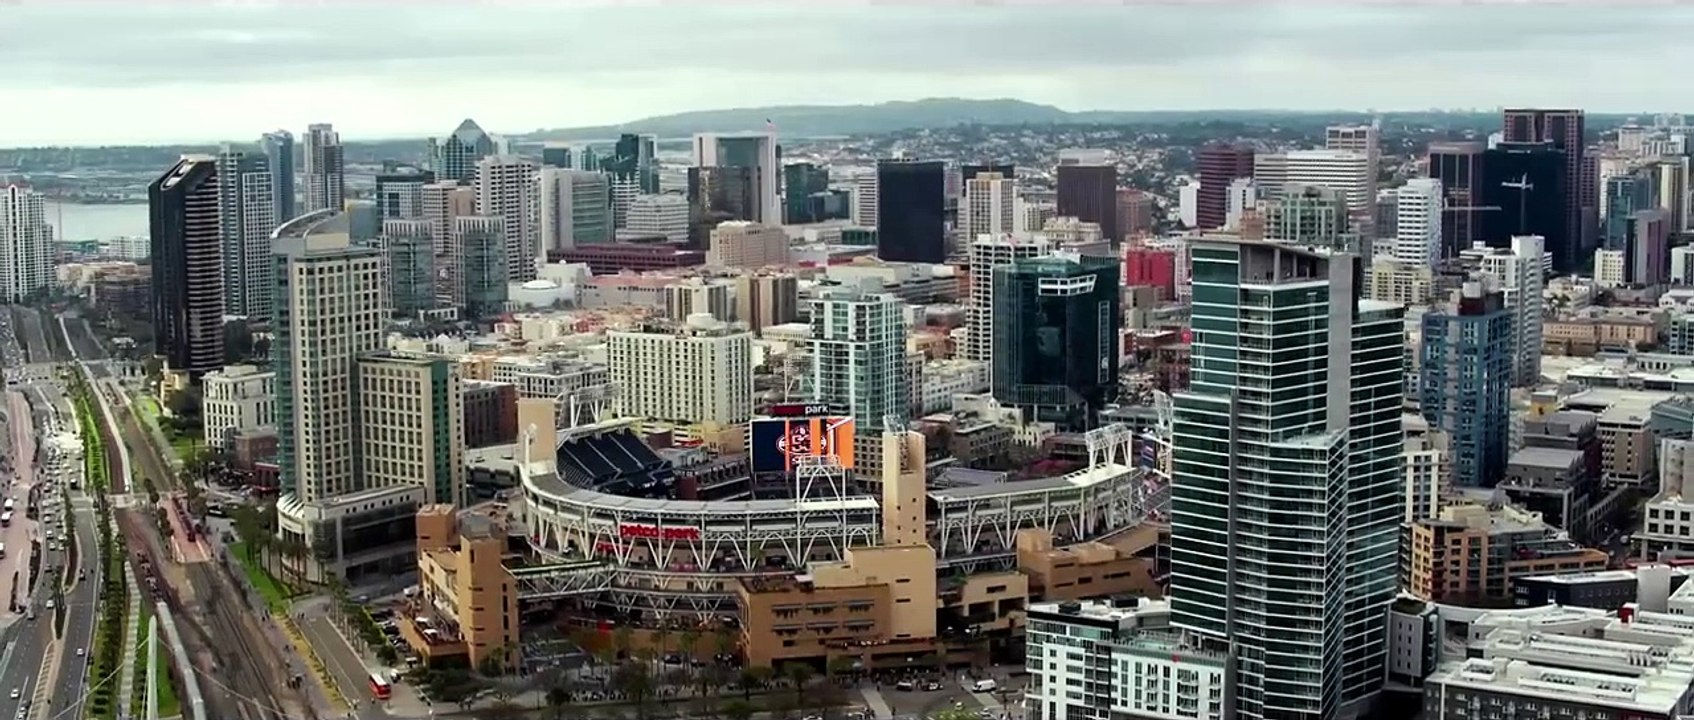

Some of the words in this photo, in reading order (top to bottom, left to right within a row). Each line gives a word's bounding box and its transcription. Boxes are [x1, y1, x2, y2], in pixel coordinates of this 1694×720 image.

[804, 405, 829, 414] park
[620, 524, 659, 538] petco
[664, 527, 700, 540] park
